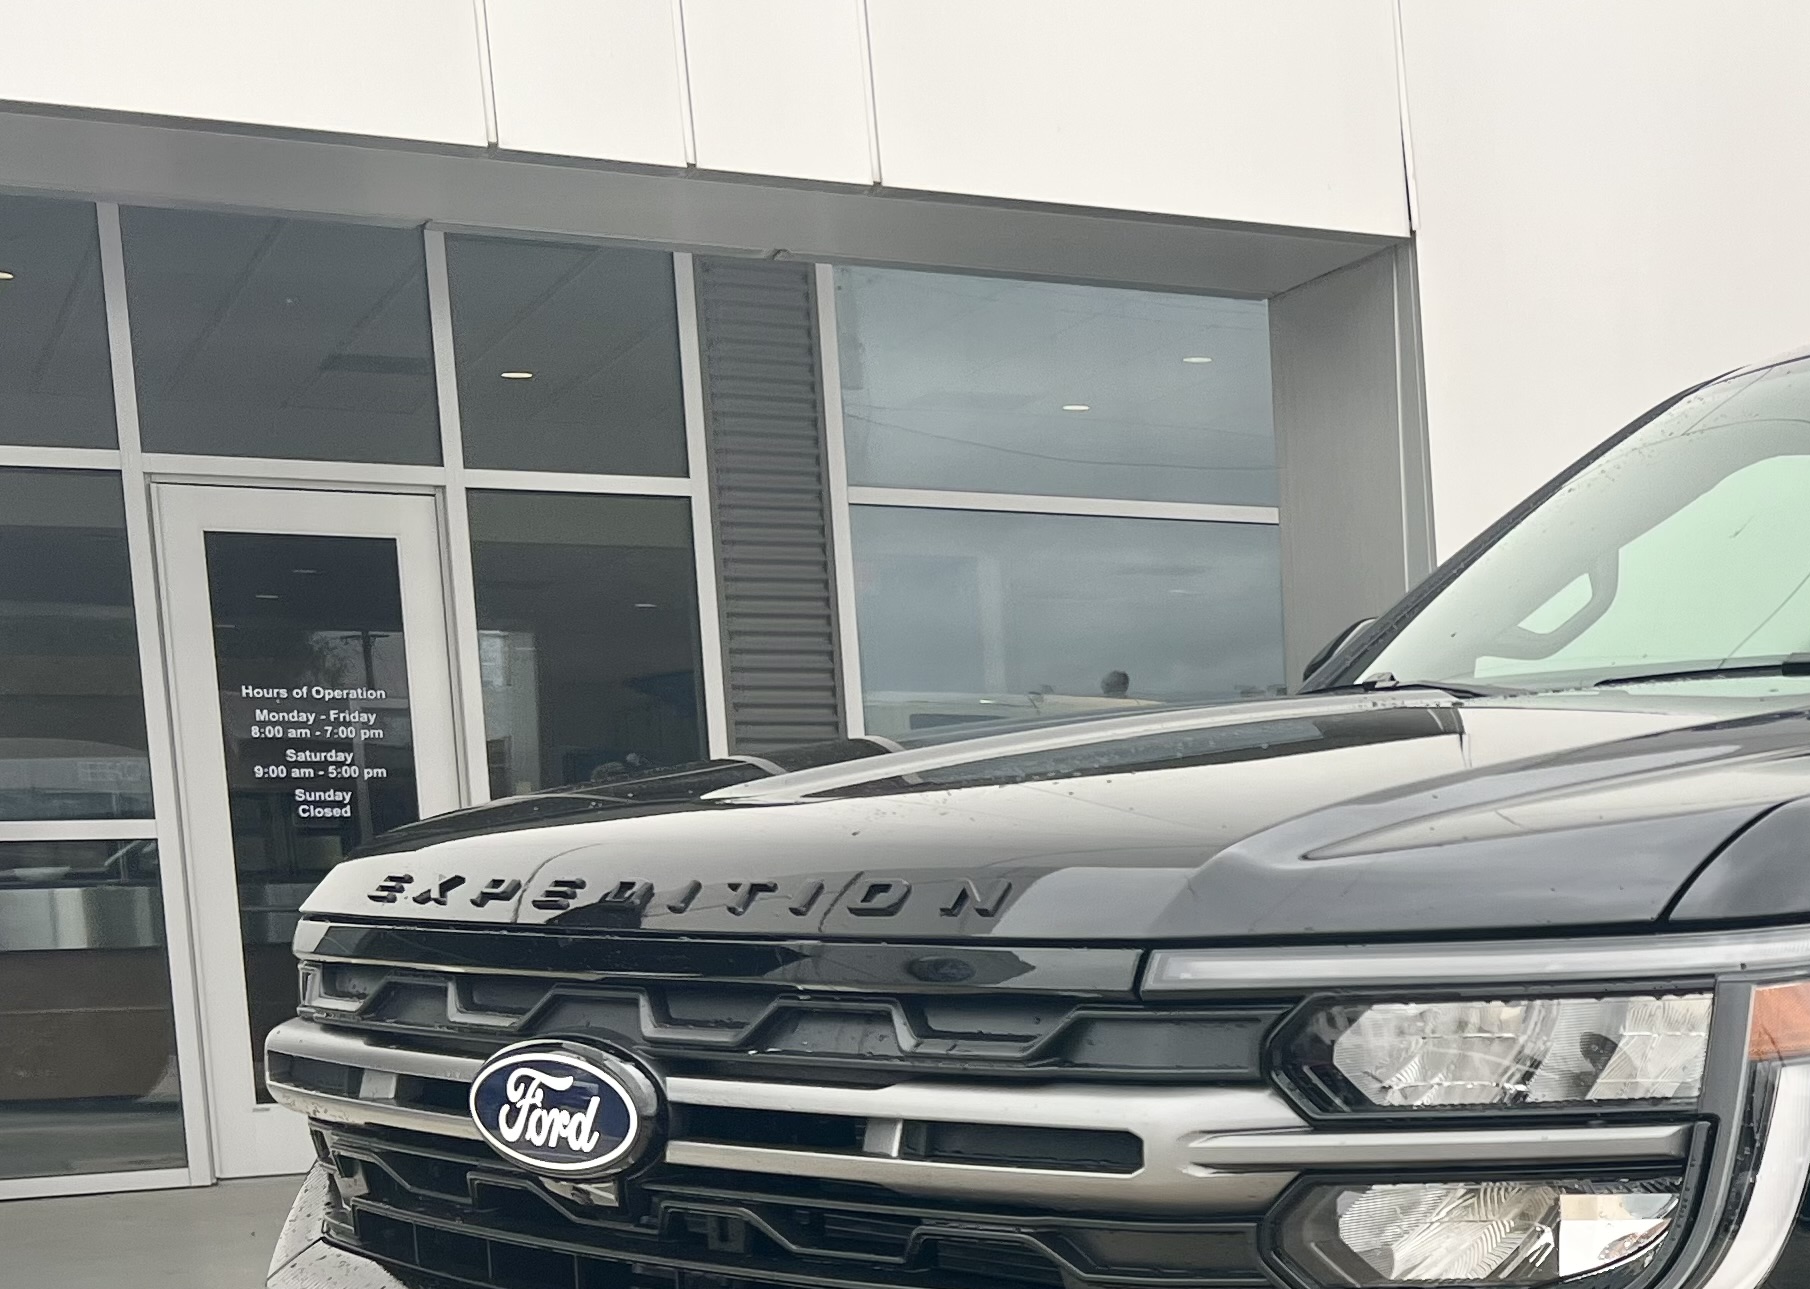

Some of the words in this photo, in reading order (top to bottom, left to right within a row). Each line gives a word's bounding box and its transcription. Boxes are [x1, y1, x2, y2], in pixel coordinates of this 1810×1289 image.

[241, 685, 288, 699] Hours
[292, 686, 308, 698] of
[311, 686, 386, 701] Operation
[255, 709, 316, 725] Monday
[329, 710, 377, 725] Friday
[251, 726, 283, 738] 8:00
[288, 729, 311, 738] am
[324, 727, 356, 738] 7:00
[360, 729, 384, 741] pm
[285, 749, 354, 764] Saturday
[254, 766, 287, 778] 9:00
[291, 769, 314, 778] am
[328, 766, 360, 778] 5:00
[364, 769, 387, 781] pm
[294, 789, 352, 804] Sunday
[298, 805, 351, 818] Closed
[367, 873, 1013, 917] EXPEDITION
[498, 1066, 602, 1155] Ford
